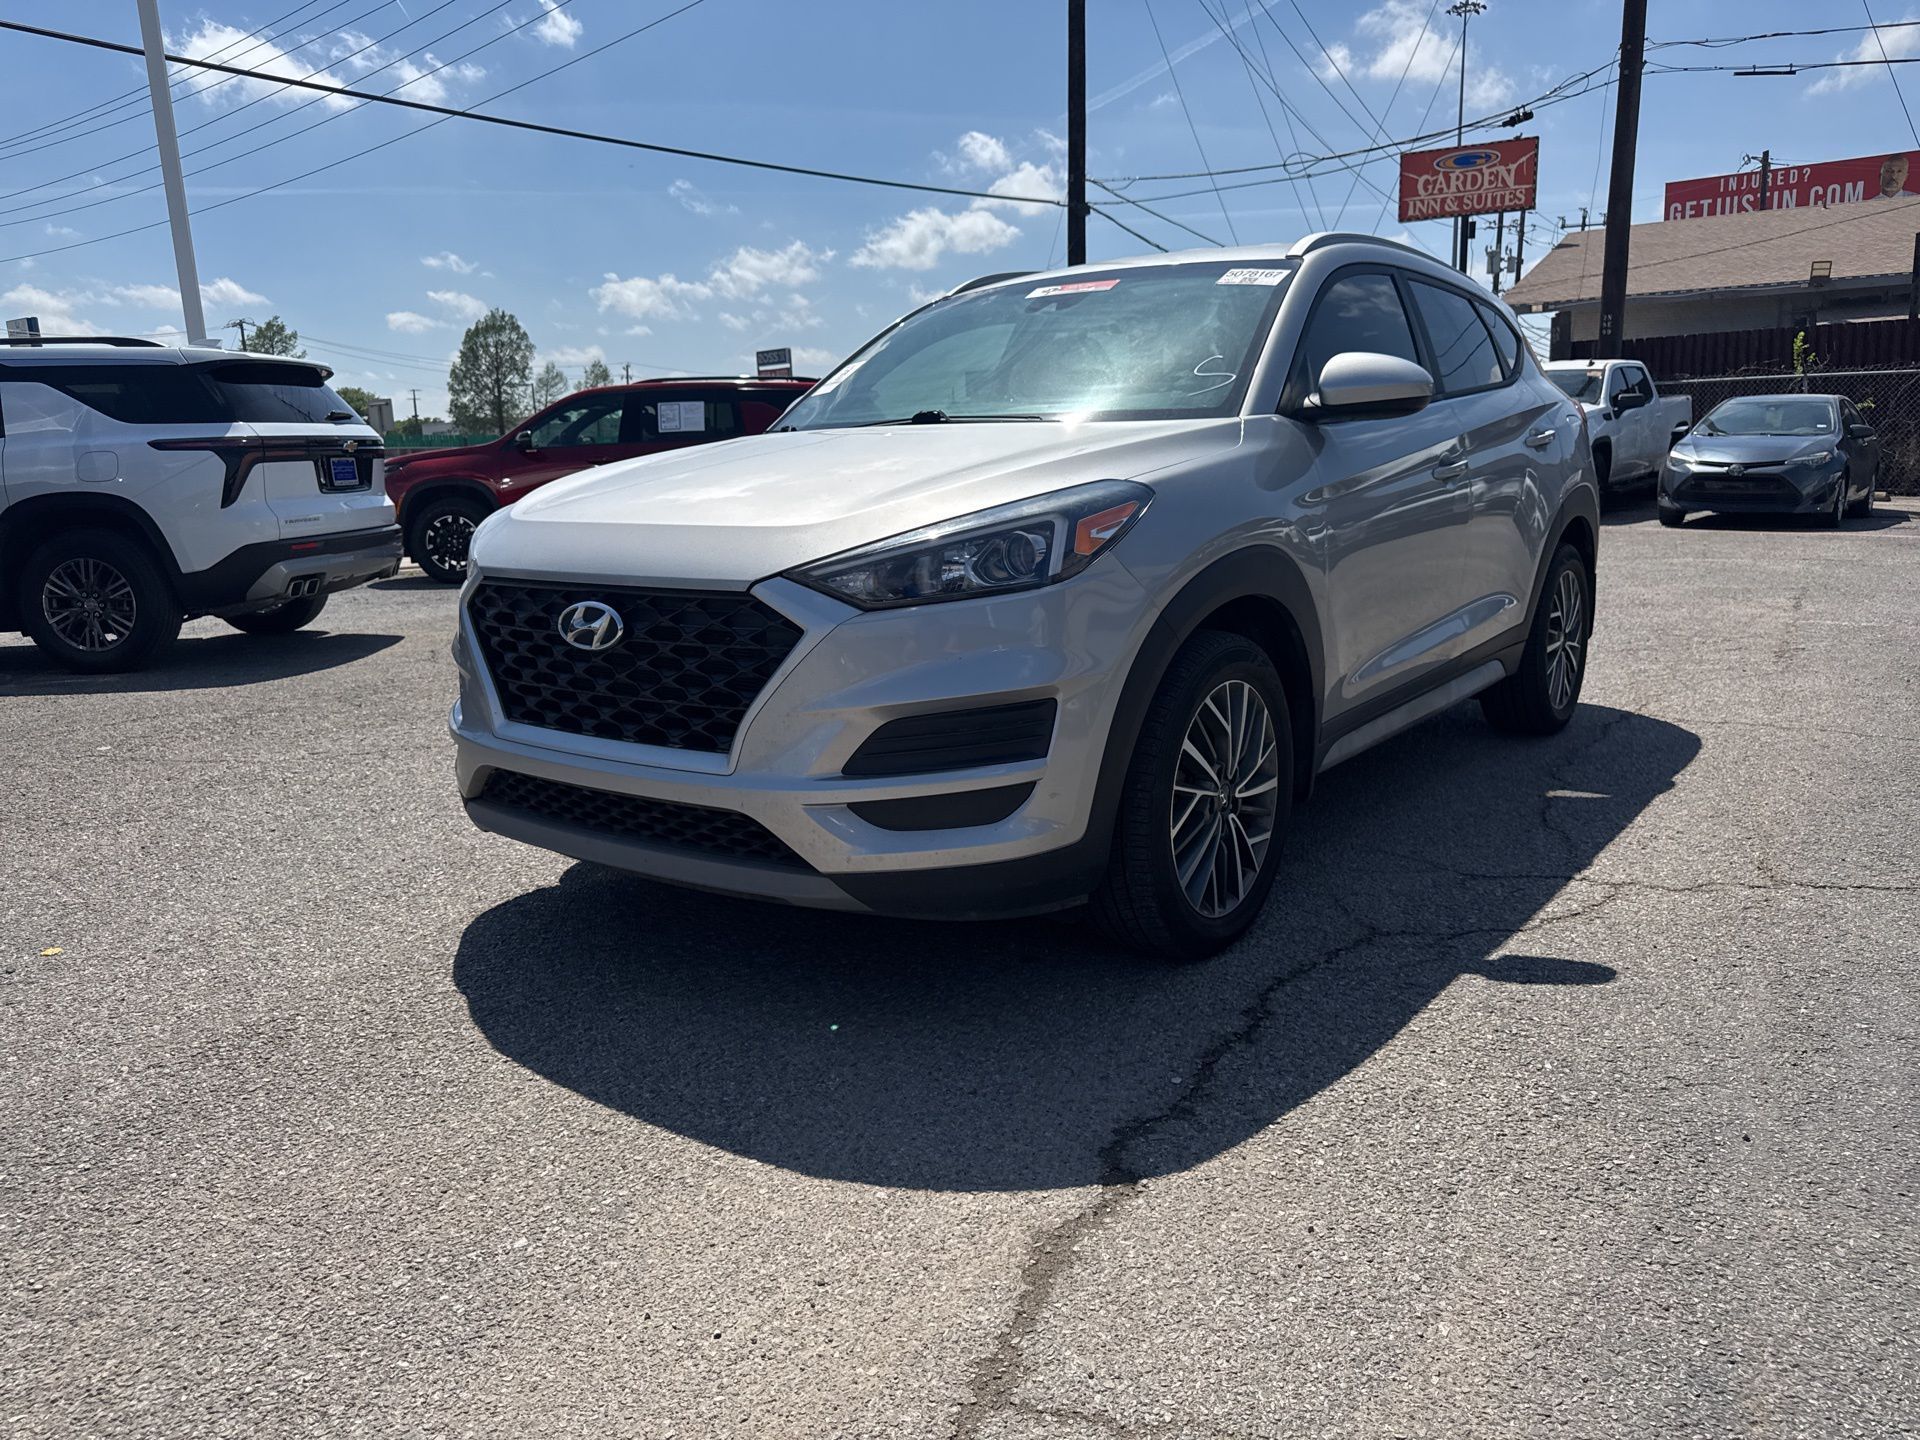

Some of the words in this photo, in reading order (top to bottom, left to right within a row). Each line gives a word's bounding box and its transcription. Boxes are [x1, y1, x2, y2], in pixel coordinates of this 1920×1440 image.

[1417, 164, 1516, 197] GARDEN
[1720, 168, 1811, 192] INJURED?
[1407, 199, 1440, 216] INN
[1444, 196, 1459, 212] &
[1463, 189, 1526, 210] SUITES
